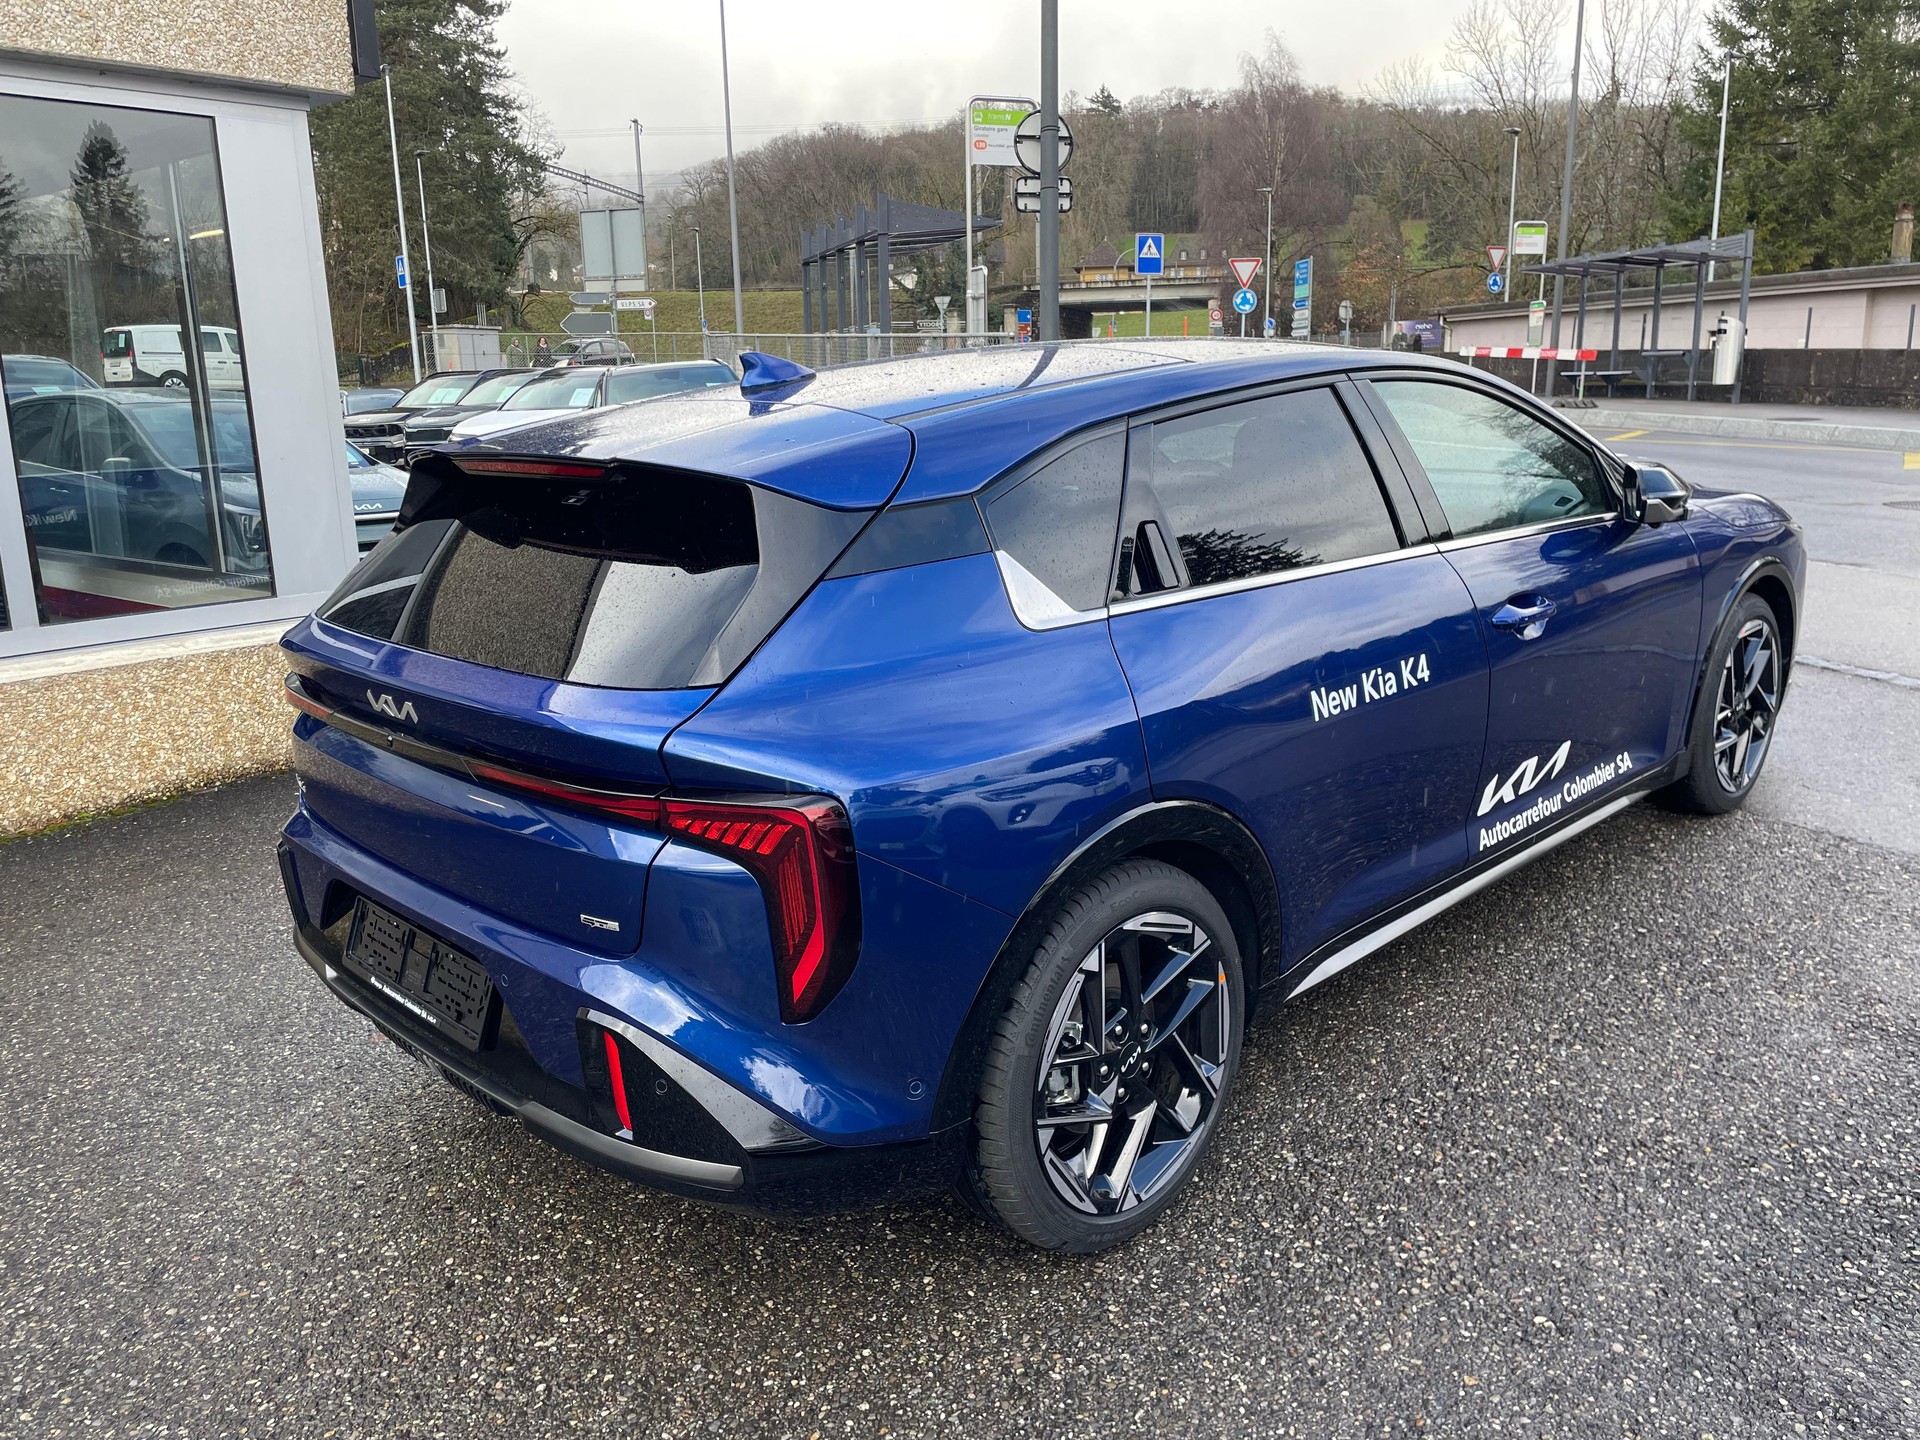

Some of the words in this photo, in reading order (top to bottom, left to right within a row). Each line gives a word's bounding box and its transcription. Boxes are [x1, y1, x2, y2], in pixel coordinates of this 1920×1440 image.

[366, 689, 419, 725] KIA
[1310, 684, 1357, 722] New
[1361, 667, 1397, 703] Kia
[1400, 653, 1430, 690] K4
[1477, 739, 1572, 817] KIA
[1479, 793, 1563, 852] Autocarrefour
[1563, 762, 1616, 803] Colombier
[1616, 751, 1633, 774] SA
